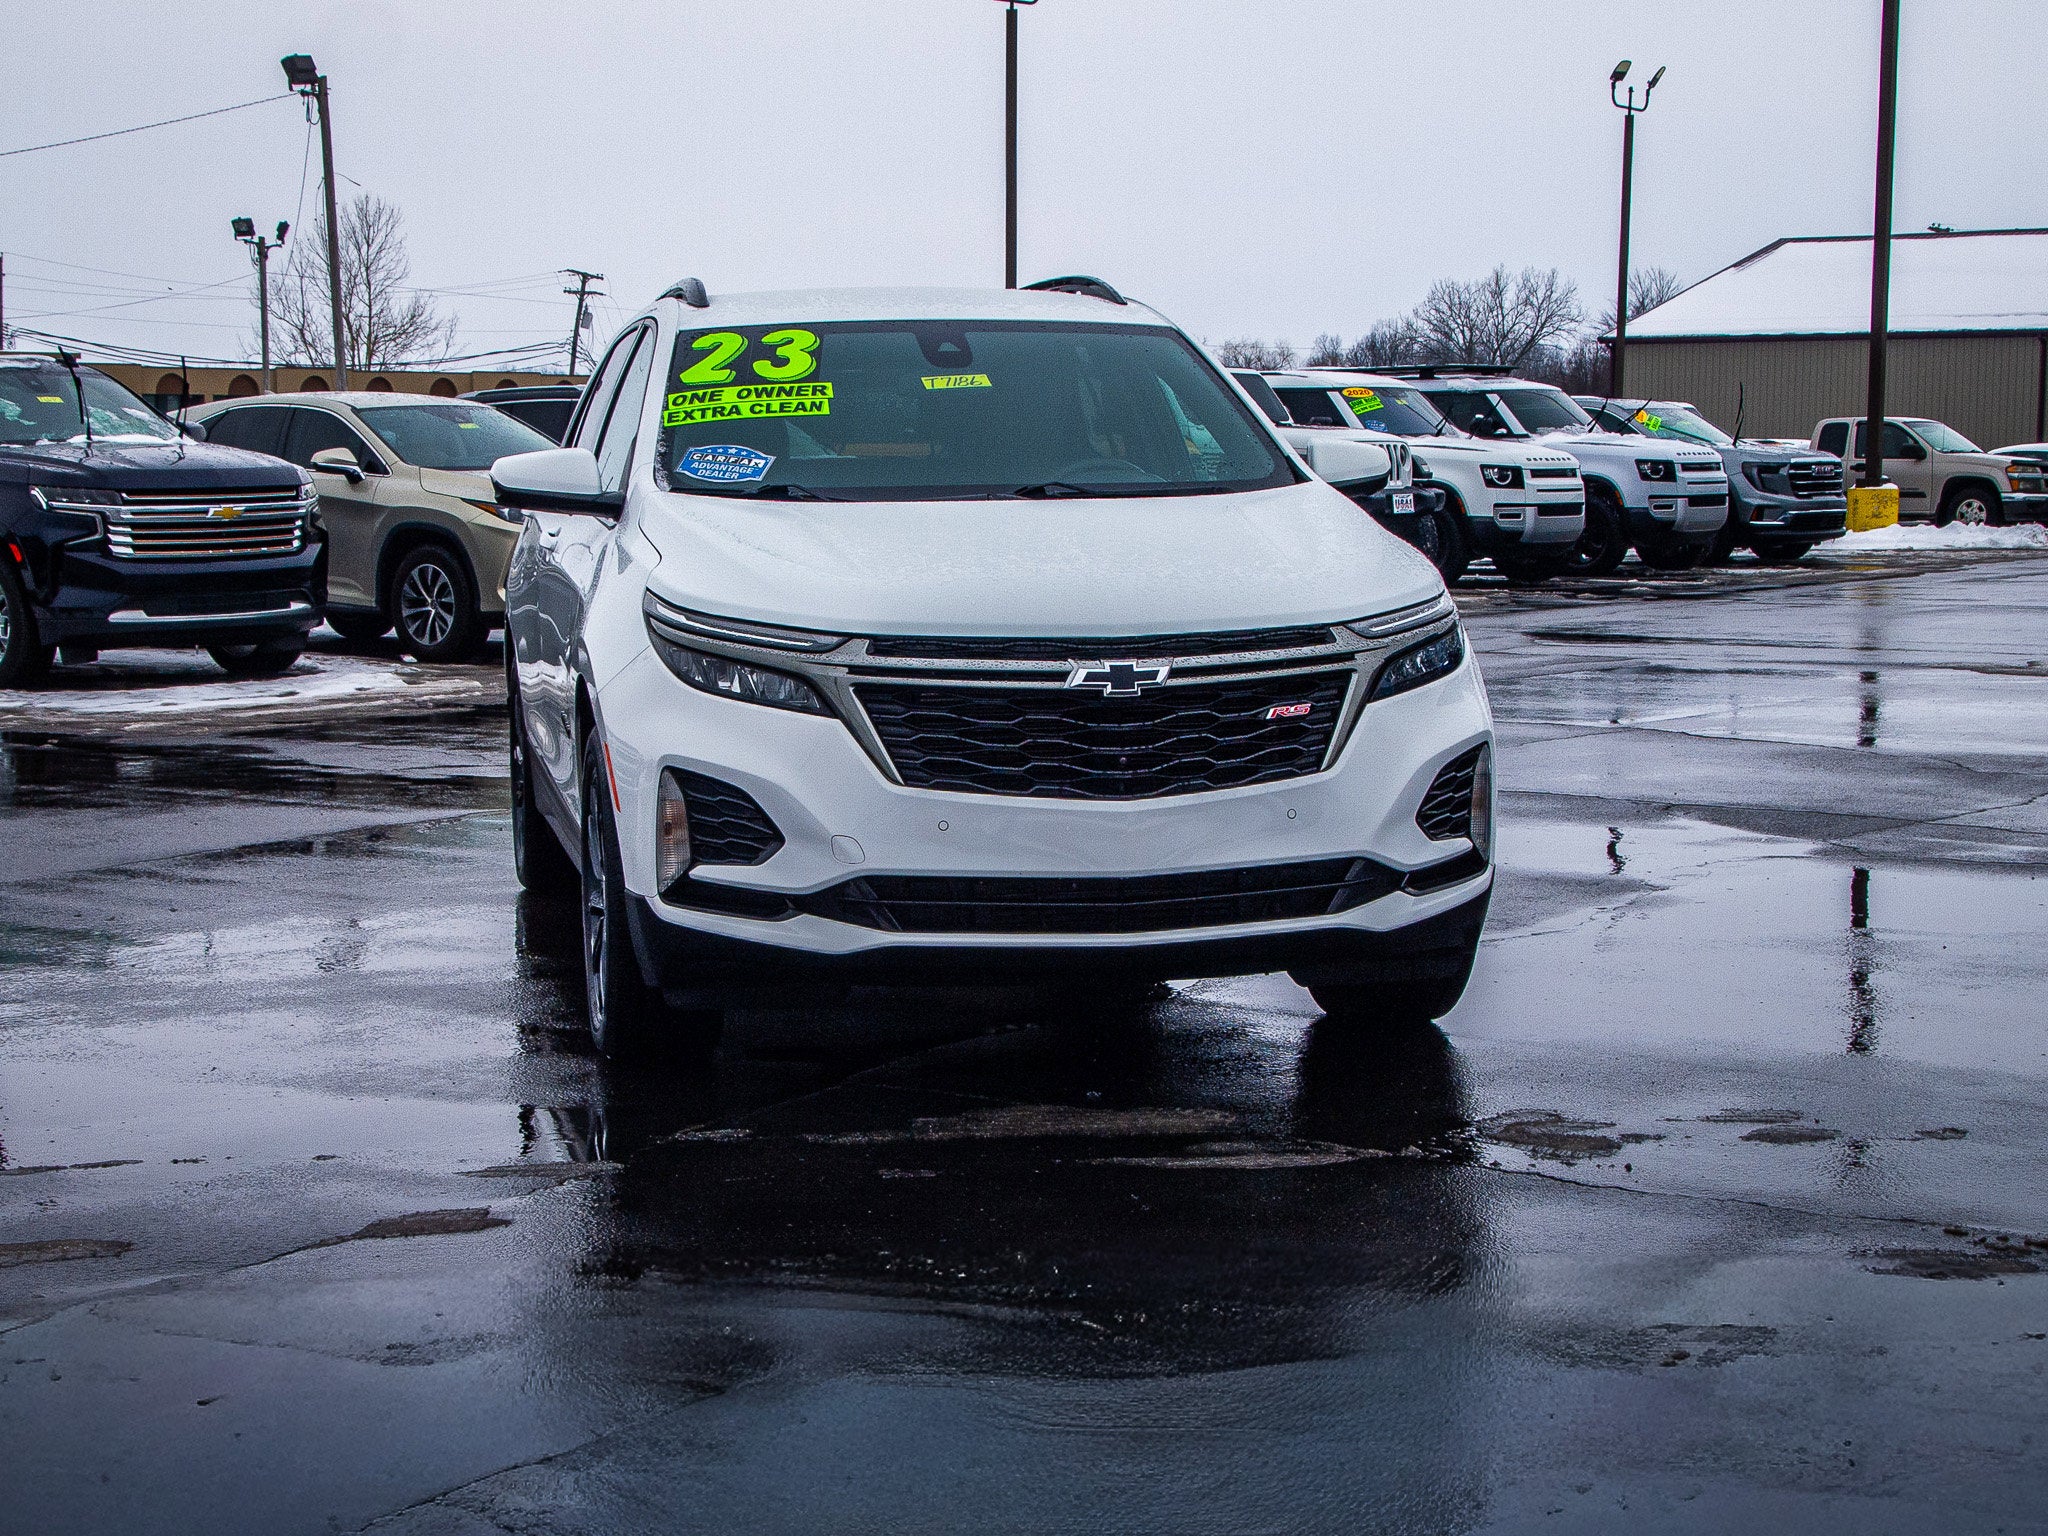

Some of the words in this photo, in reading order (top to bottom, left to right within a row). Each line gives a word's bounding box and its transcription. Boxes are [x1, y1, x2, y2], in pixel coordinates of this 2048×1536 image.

[679, 329, 820, 385] 23
[672, 390, 724, 407] ONE
[736, 385, 828, 400] OWNER
[667, 405, 742, 424] EXTRA
[750, 401, 823, 415] CLEAN
[690, 453, 765, 468] CARFAX
[691, 462, 754, 474] ADVANTAGE
[697, 470, 739, 479] DEALER
[1266, 704, 1311, 719] RS
